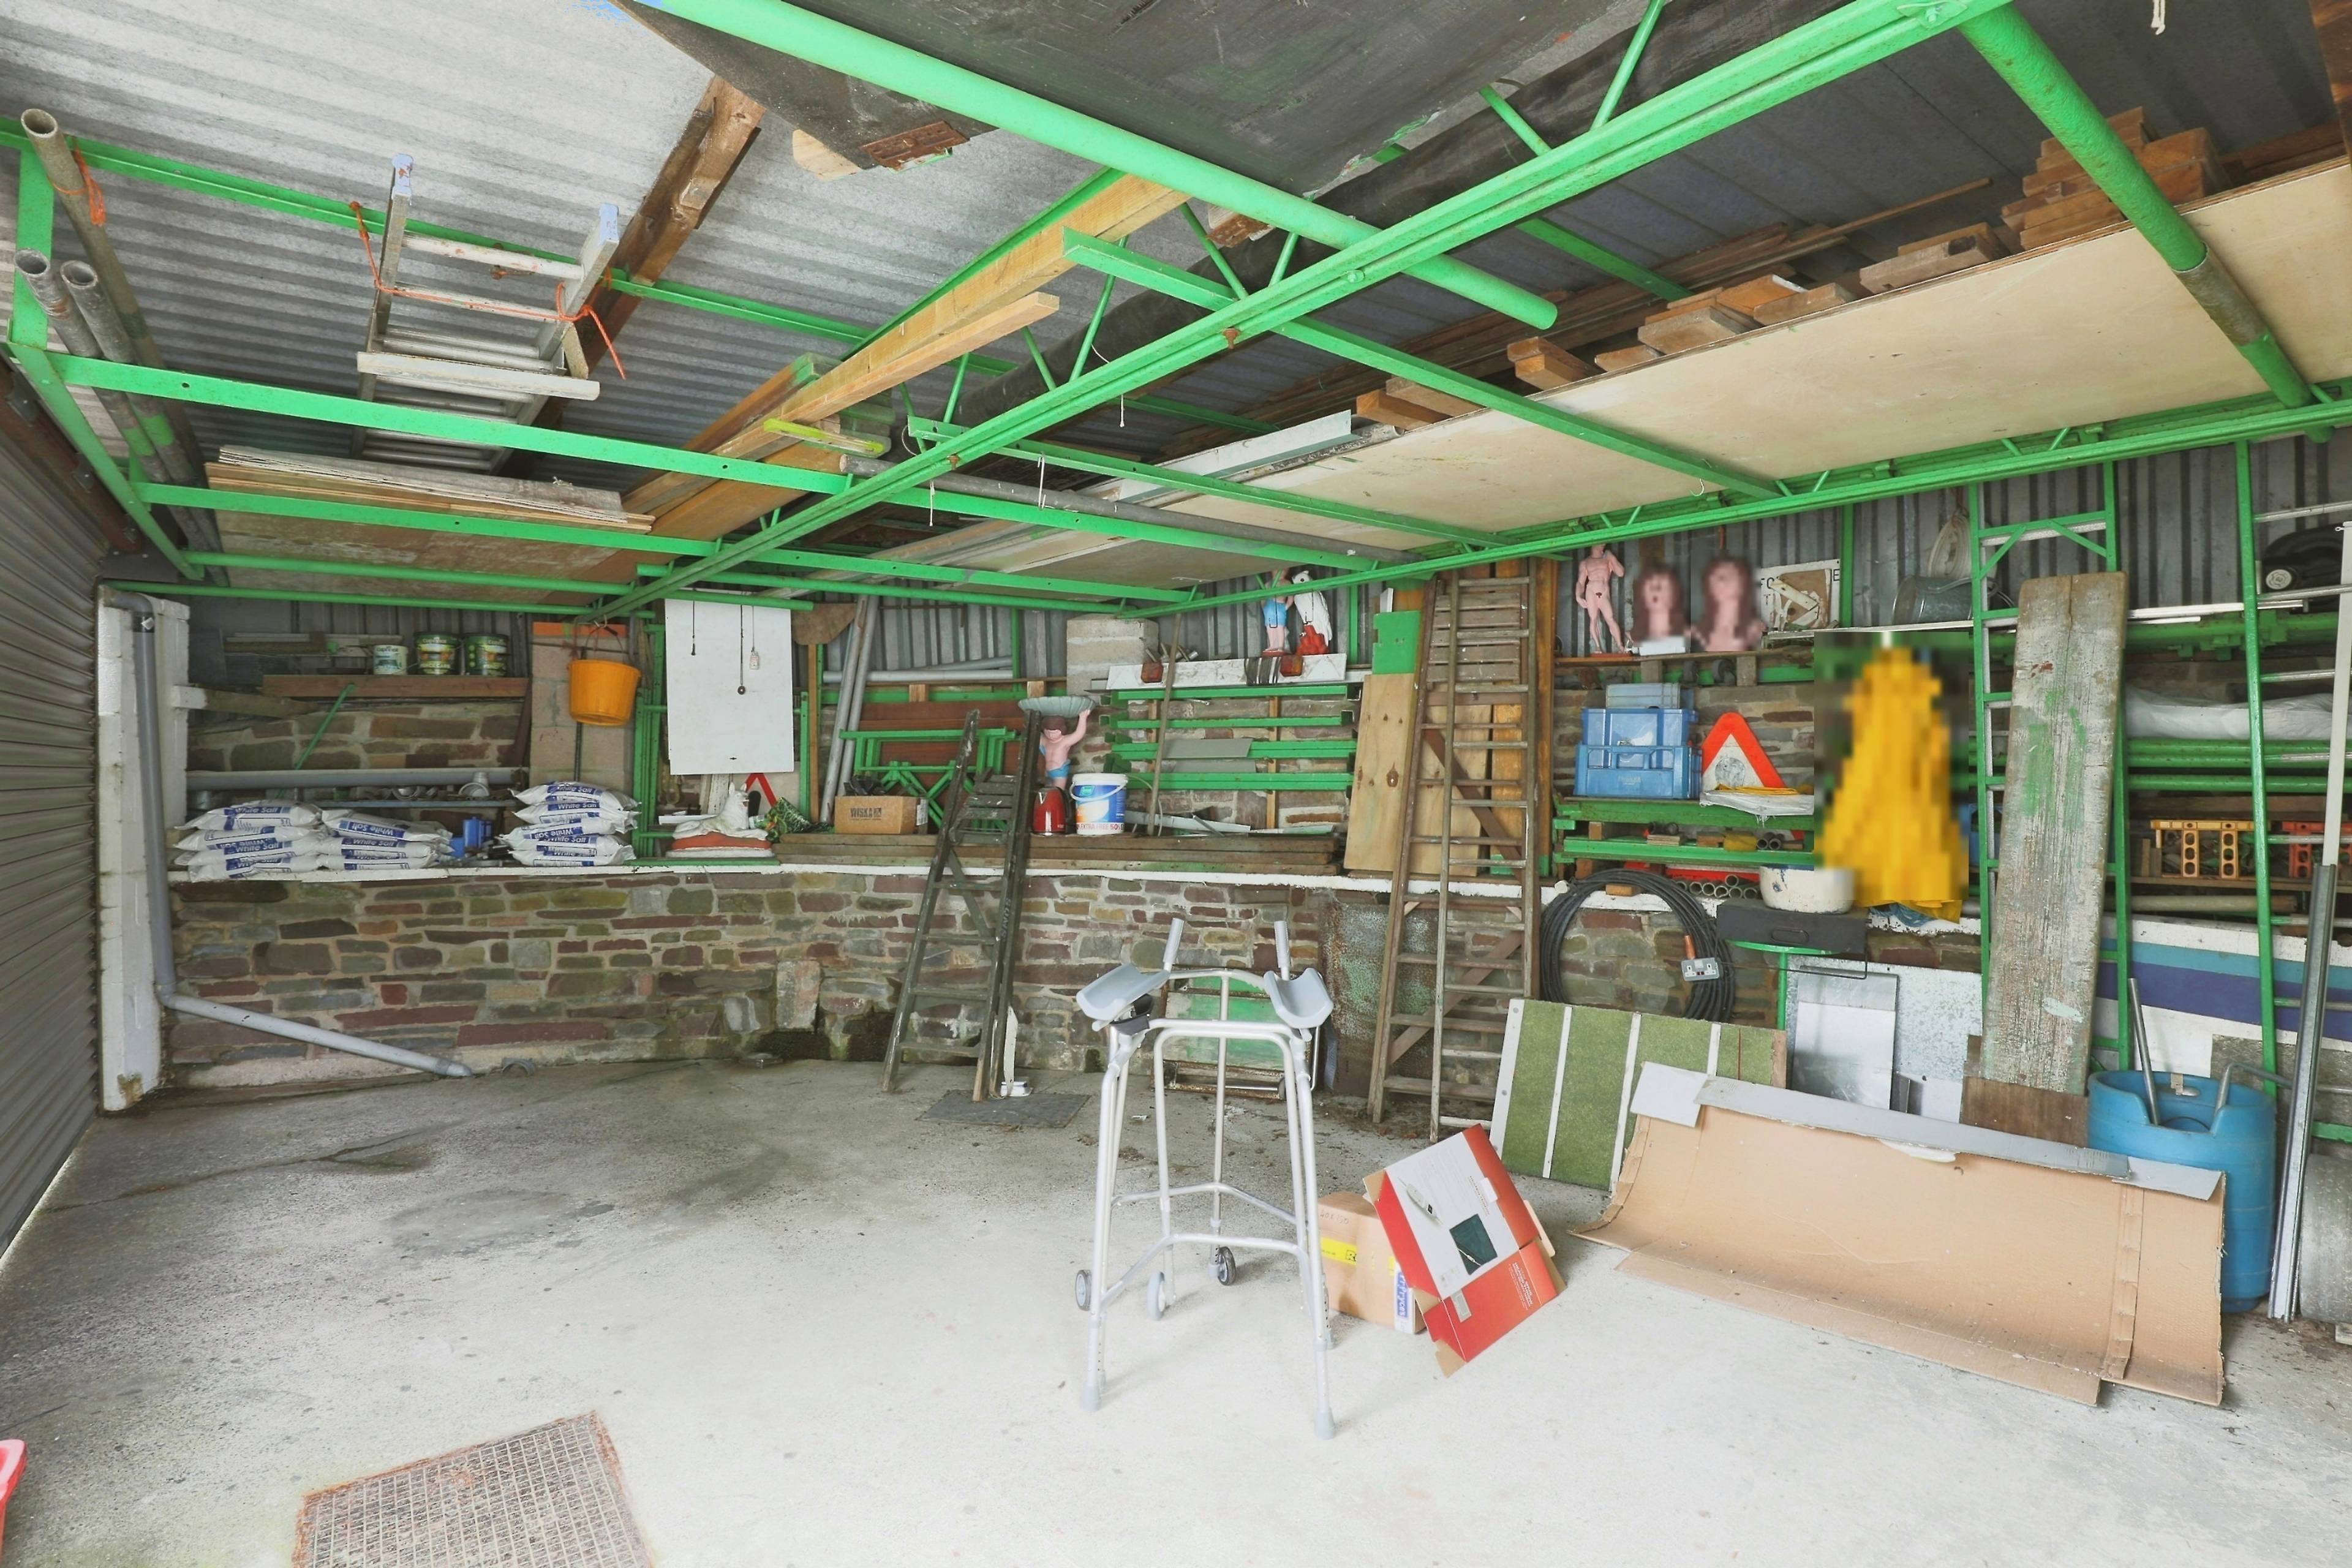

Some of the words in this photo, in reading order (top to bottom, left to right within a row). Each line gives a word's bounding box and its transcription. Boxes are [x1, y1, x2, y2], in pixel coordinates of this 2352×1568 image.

[850, 807, 873, 818] WISKA
[352, 822, 368, 831] Salt
[370, 824, 393, 835] White
